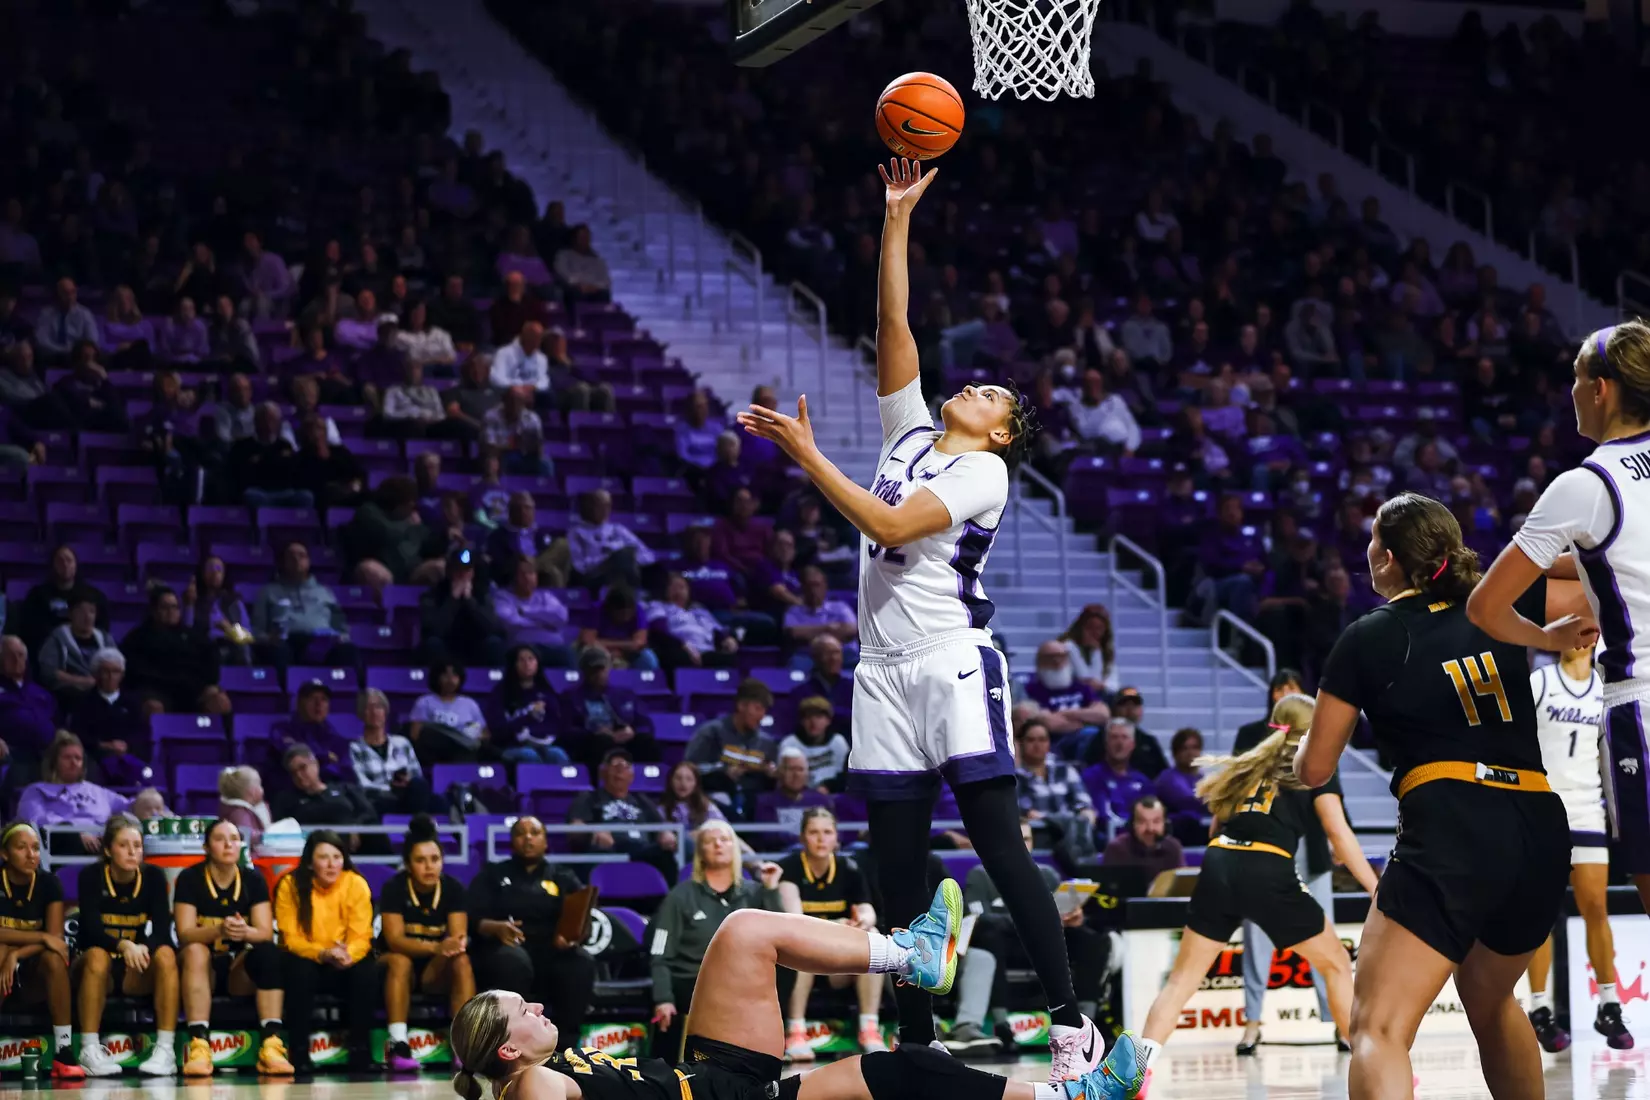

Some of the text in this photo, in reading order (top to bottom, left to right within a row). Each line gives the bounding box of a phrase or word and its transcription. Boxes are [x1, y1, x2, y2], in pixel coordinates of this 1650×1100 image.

[1442, 651, 1513, 727] 14
[1569, 729, 1577, 758] 1
[1277, 1007, 1302, 1021] WE
